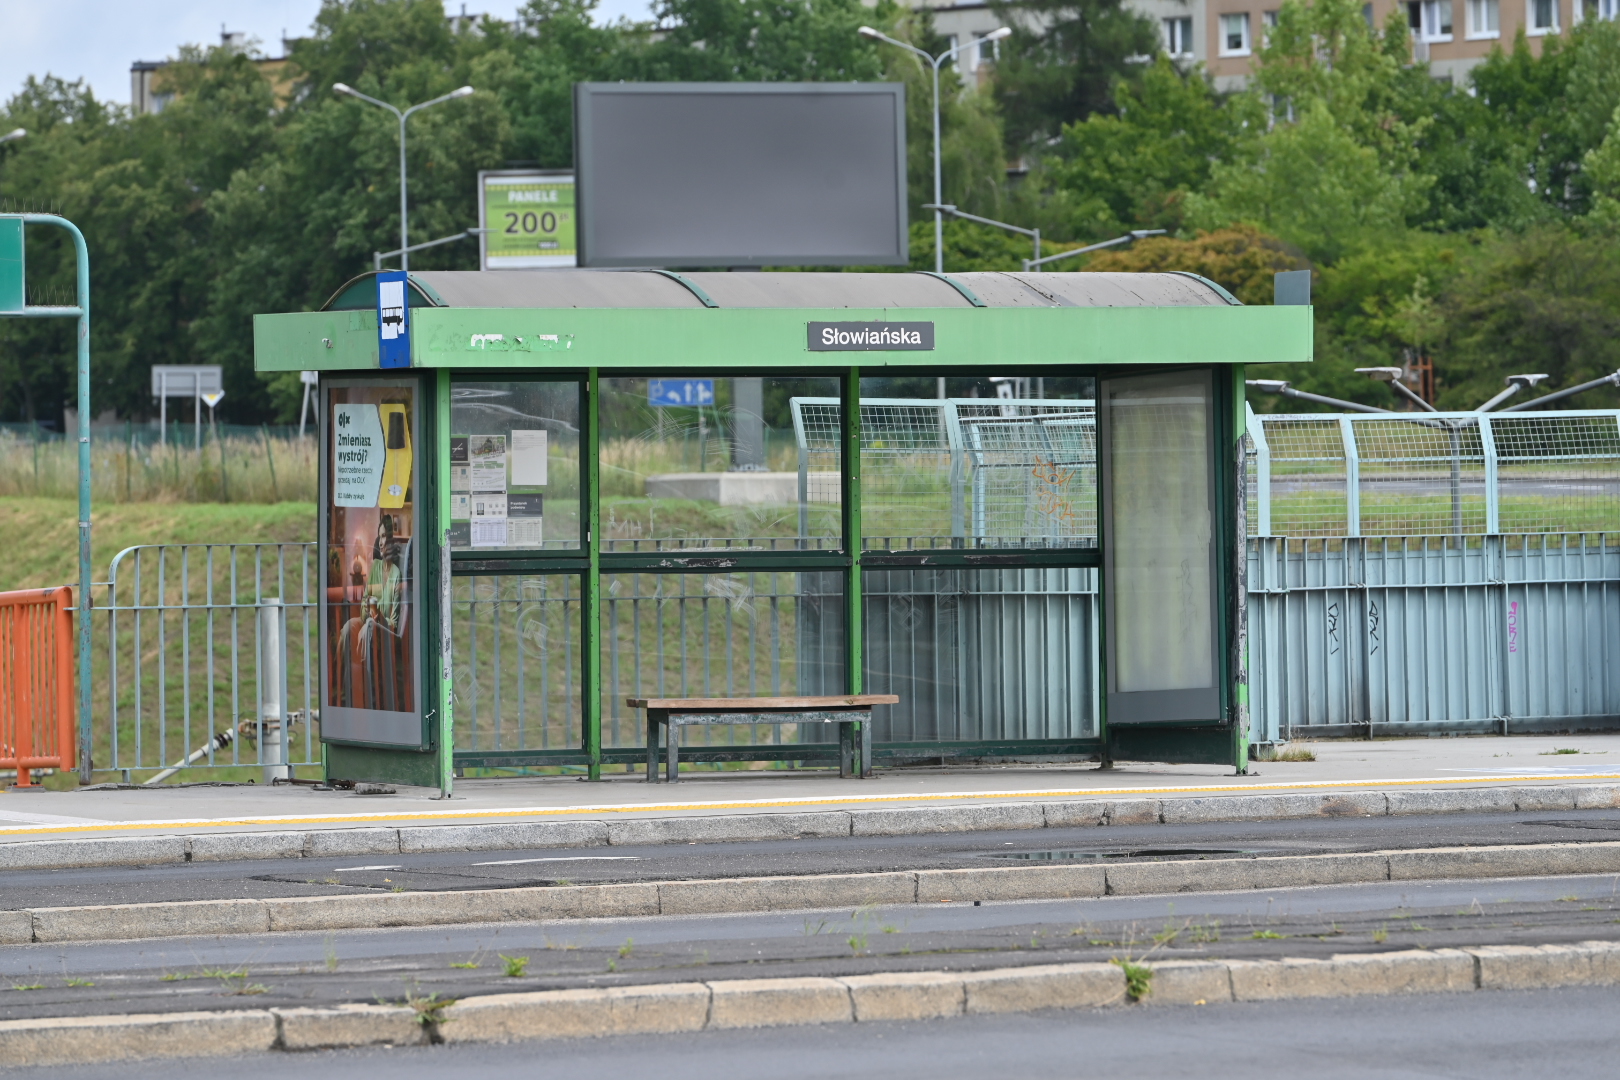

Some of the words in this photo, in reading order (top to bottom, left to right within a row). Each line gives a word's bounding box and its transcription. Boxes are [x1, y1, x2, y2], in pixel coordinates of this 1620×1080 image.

[508, 190, 558, 203] PANELE
[505, 211, 556, 234] 200
[822, 327, 922, 345] Słowiańska
[338, 433, 372, 447] Zmieniasz
[338, 448, 368, 465] wystrój?
